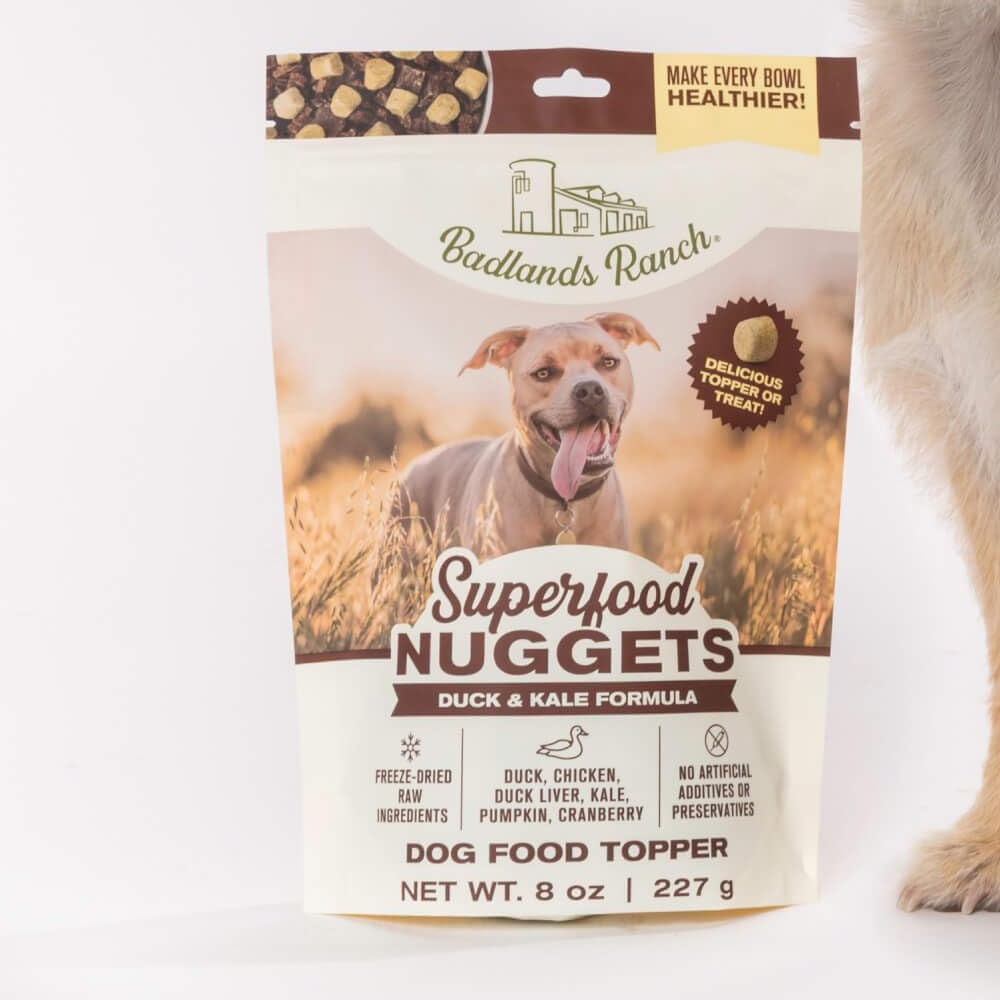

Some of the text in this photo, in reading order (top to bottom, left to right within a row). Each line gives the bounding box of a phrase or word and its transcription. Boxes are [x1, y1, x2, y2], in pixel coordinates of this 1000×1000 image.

[666, 64, 806, 89] MAKE EVERY BOWL
[667, 90, 806, 110] HEALTHIER!
[439, 225, 599, 287] Badlands
[704, 355, 783, 392] DELICIOUS
[699, 369, 783, 408] TOPPER OR
[714, 389, 766, 415] TREAT!
[431, 555, 698, 634] Superfood
[396, 629, 734, 676] NUGGETS
[438, 690, 698, 708] DUCK & KALE FORMULA
[375, 768, 453, 784] FREEZE-DRIED
[504, 767, 621, 786] DUCK, CHICKEN,
[678, 763, 753, 781] NO ARTIFICIAL
[397, 788, 423, 804] RAW
[494, 786, 629, 805] DUCK LIVER, KALE,
[678, 782, 751, 801] ADDITIVES OR
[376, 807, 448, 824] INGREDIENTS
[479, 805, 644, 825] PUMPKIN, CRANBERRY
[672, 801, 755, 820] PRESERVATIVES
[406, 837, 729, 865] DOG FOOD TOPPER
[401, 880, 458, 902] NET
[467, 880, 523, 902] WT.
[535, 881, 555, 902] 8
[566, 884, 605, 901] oz
[653, 876, 710, 898] 227
[719, 879, 734, 901] g
